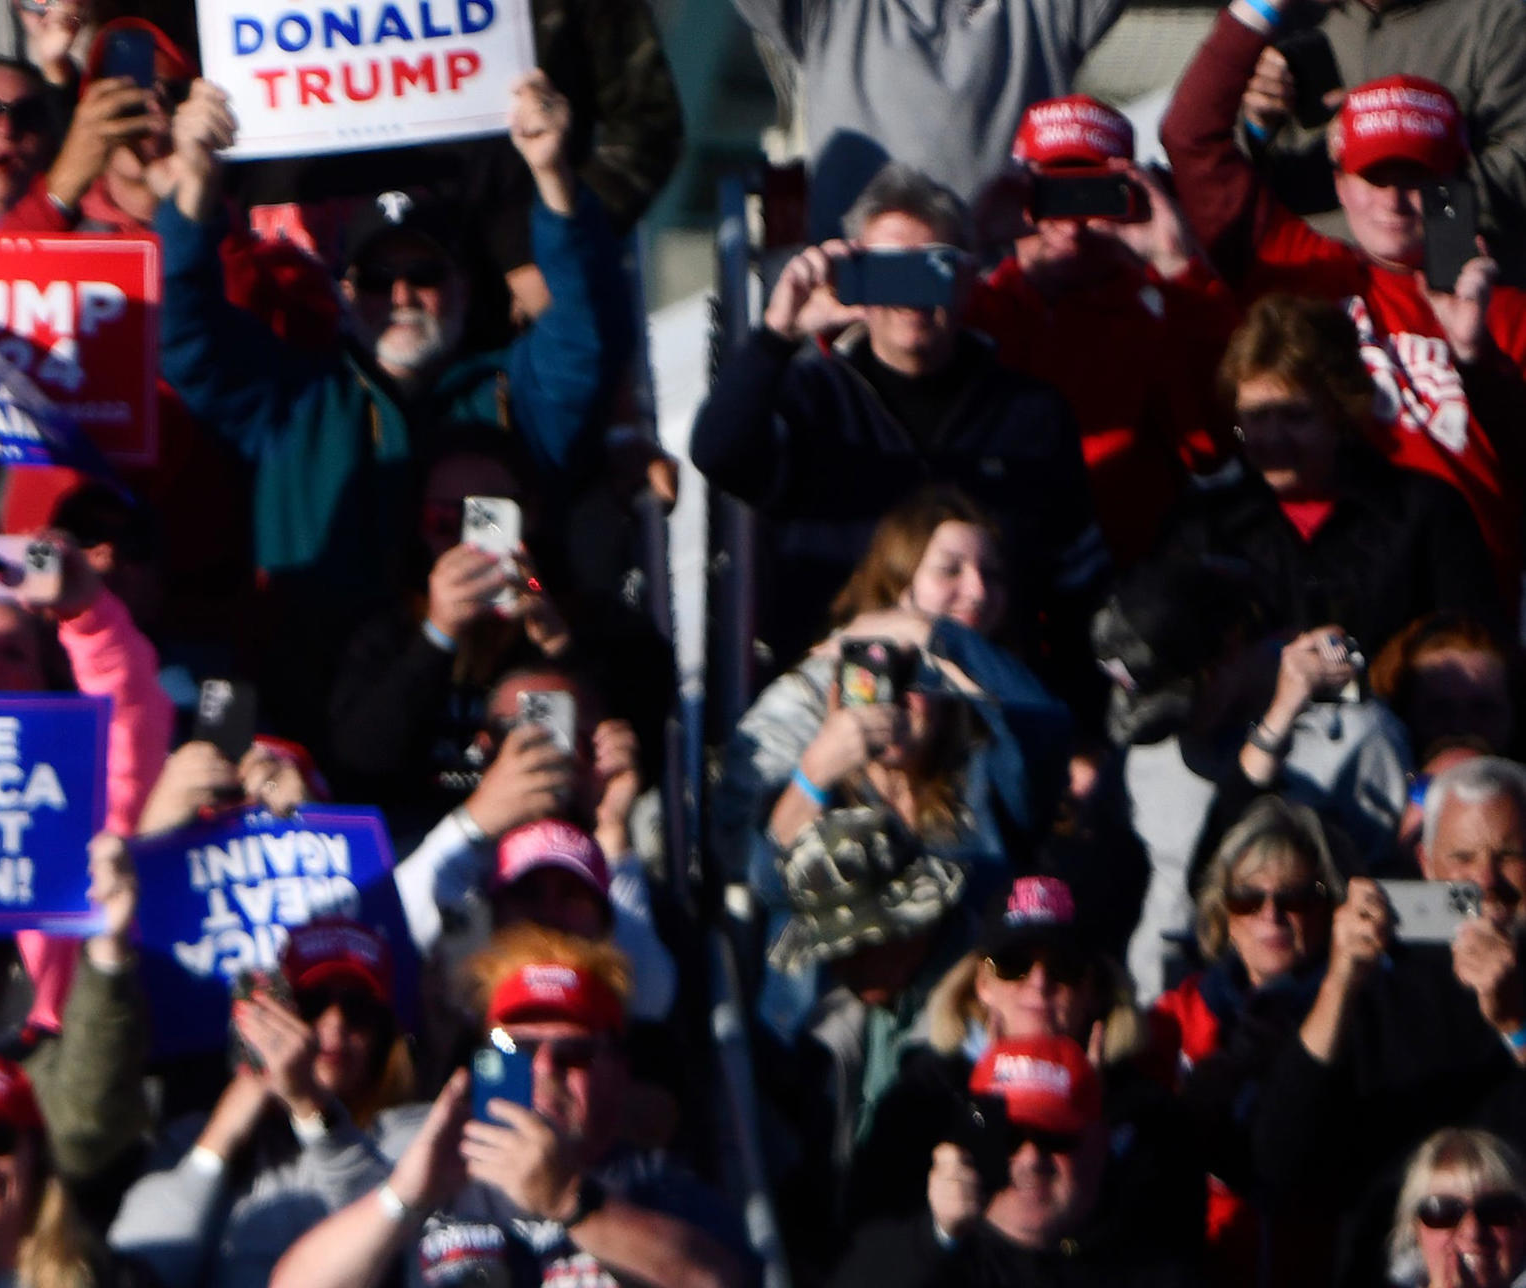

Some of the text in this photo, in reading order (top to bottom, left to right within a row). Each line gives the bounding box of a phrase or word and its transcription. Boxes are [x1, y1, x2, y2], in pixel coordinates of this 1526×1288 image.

[231, 0, 494, 56] DONALD
[253, 48, 482, 109] TRUMP
[186, 830, 353, 890] AGAIN!
